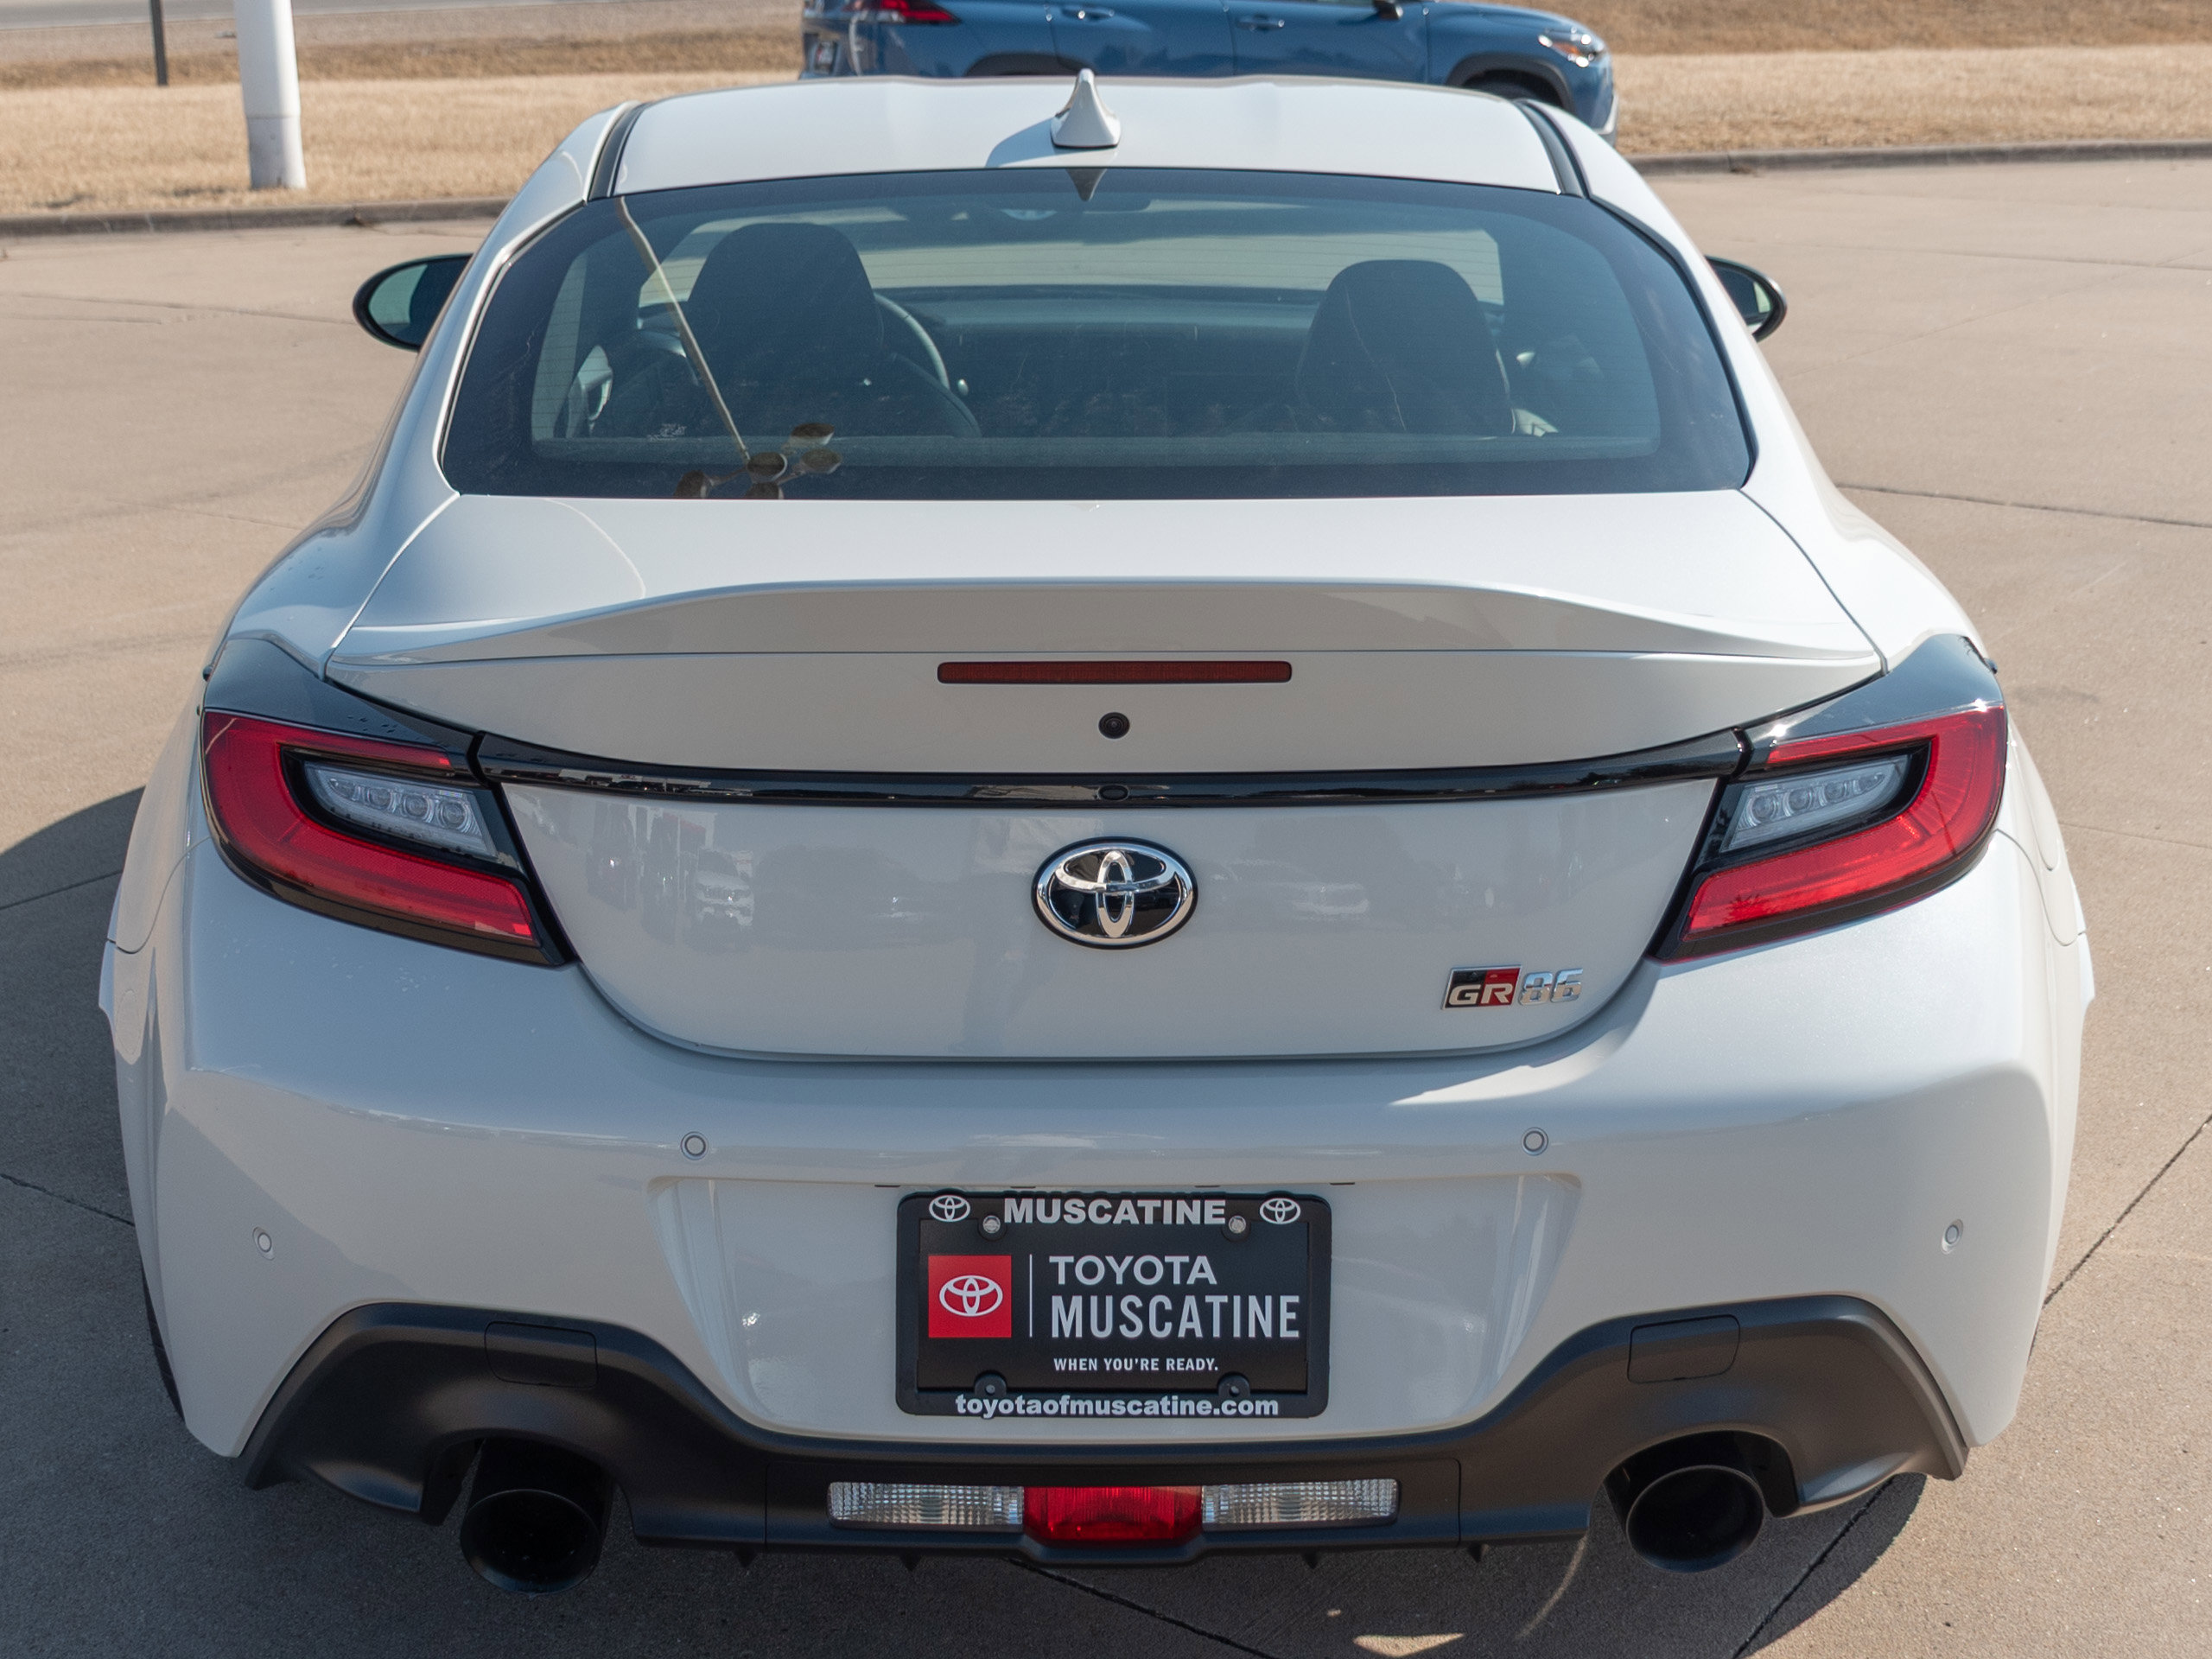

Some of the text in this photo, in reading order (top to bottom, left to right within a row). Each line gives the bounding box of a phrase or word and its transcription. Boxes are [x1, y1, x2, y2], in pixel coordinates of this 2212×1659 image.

[1448, 968, 1584, 1006] GR 86
[1003, 1198, 1226, 1225] MUSCATINE
[1049, 1255, 1217, 1285] TOYOTA
[1052, 1294, 1300, 1338] MUSCATINE
[1053, 1357, 1219, 1372] WHEN YOU'RE READY.
[955, 1393, 1279, 1419] toyotaofmuscatine.com
